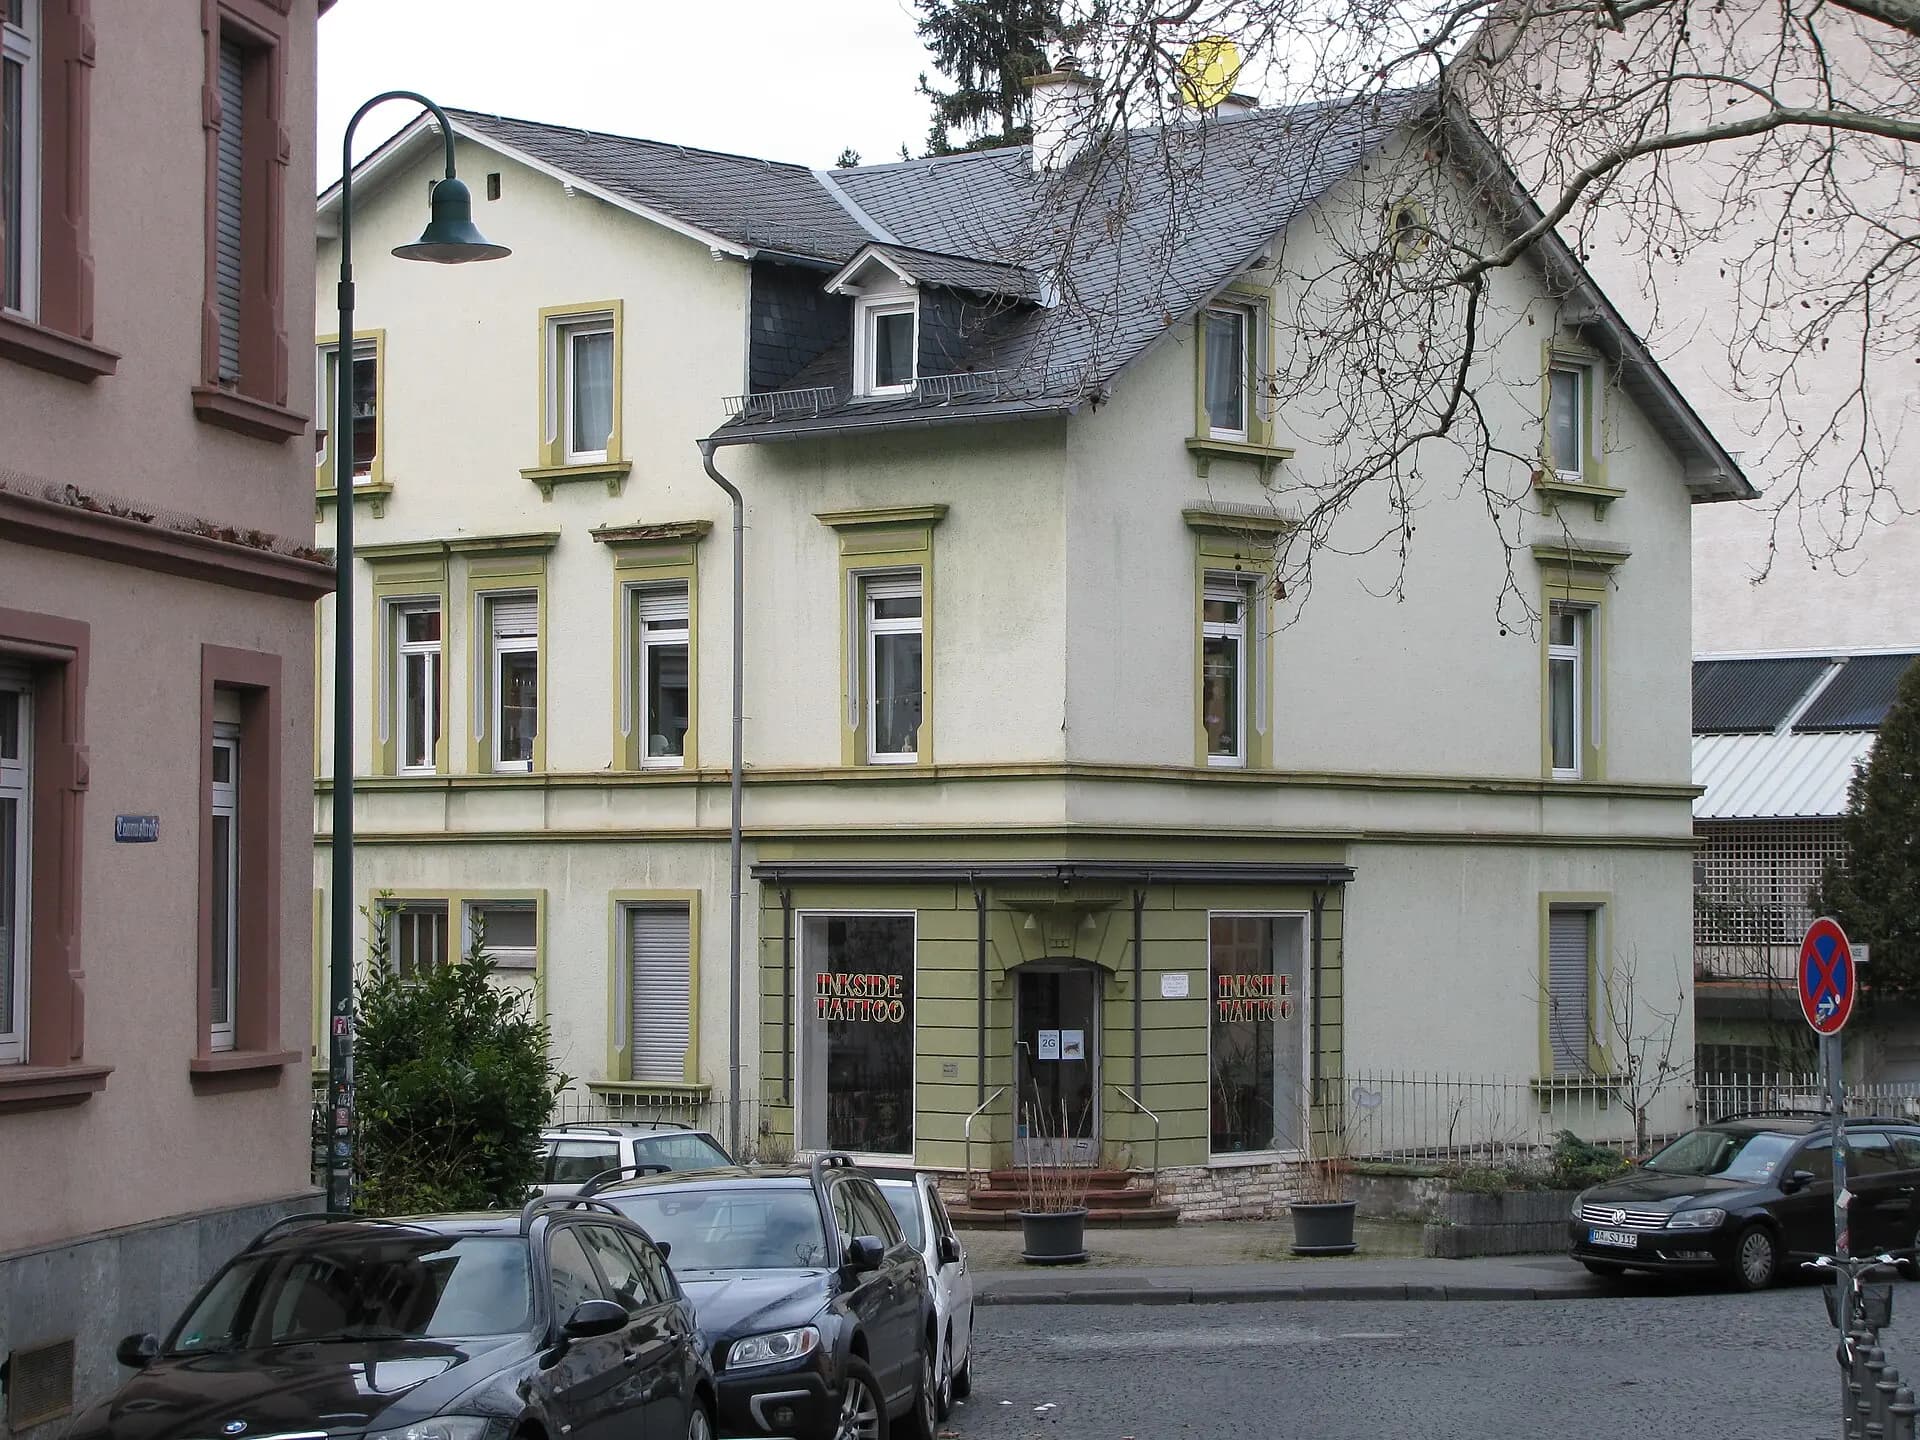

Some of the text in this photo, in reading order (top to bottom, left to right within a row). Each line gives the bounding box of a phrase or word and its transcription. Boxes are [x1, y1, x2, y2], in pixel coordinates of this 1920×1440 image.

[816, 972, 903, 998] INKSIDE
[813, 997, 905, 1022] TATTOO
[1216, 998, 1295, 1022] TATTOO
[1042, 1038, 1056, 1048] 2G
